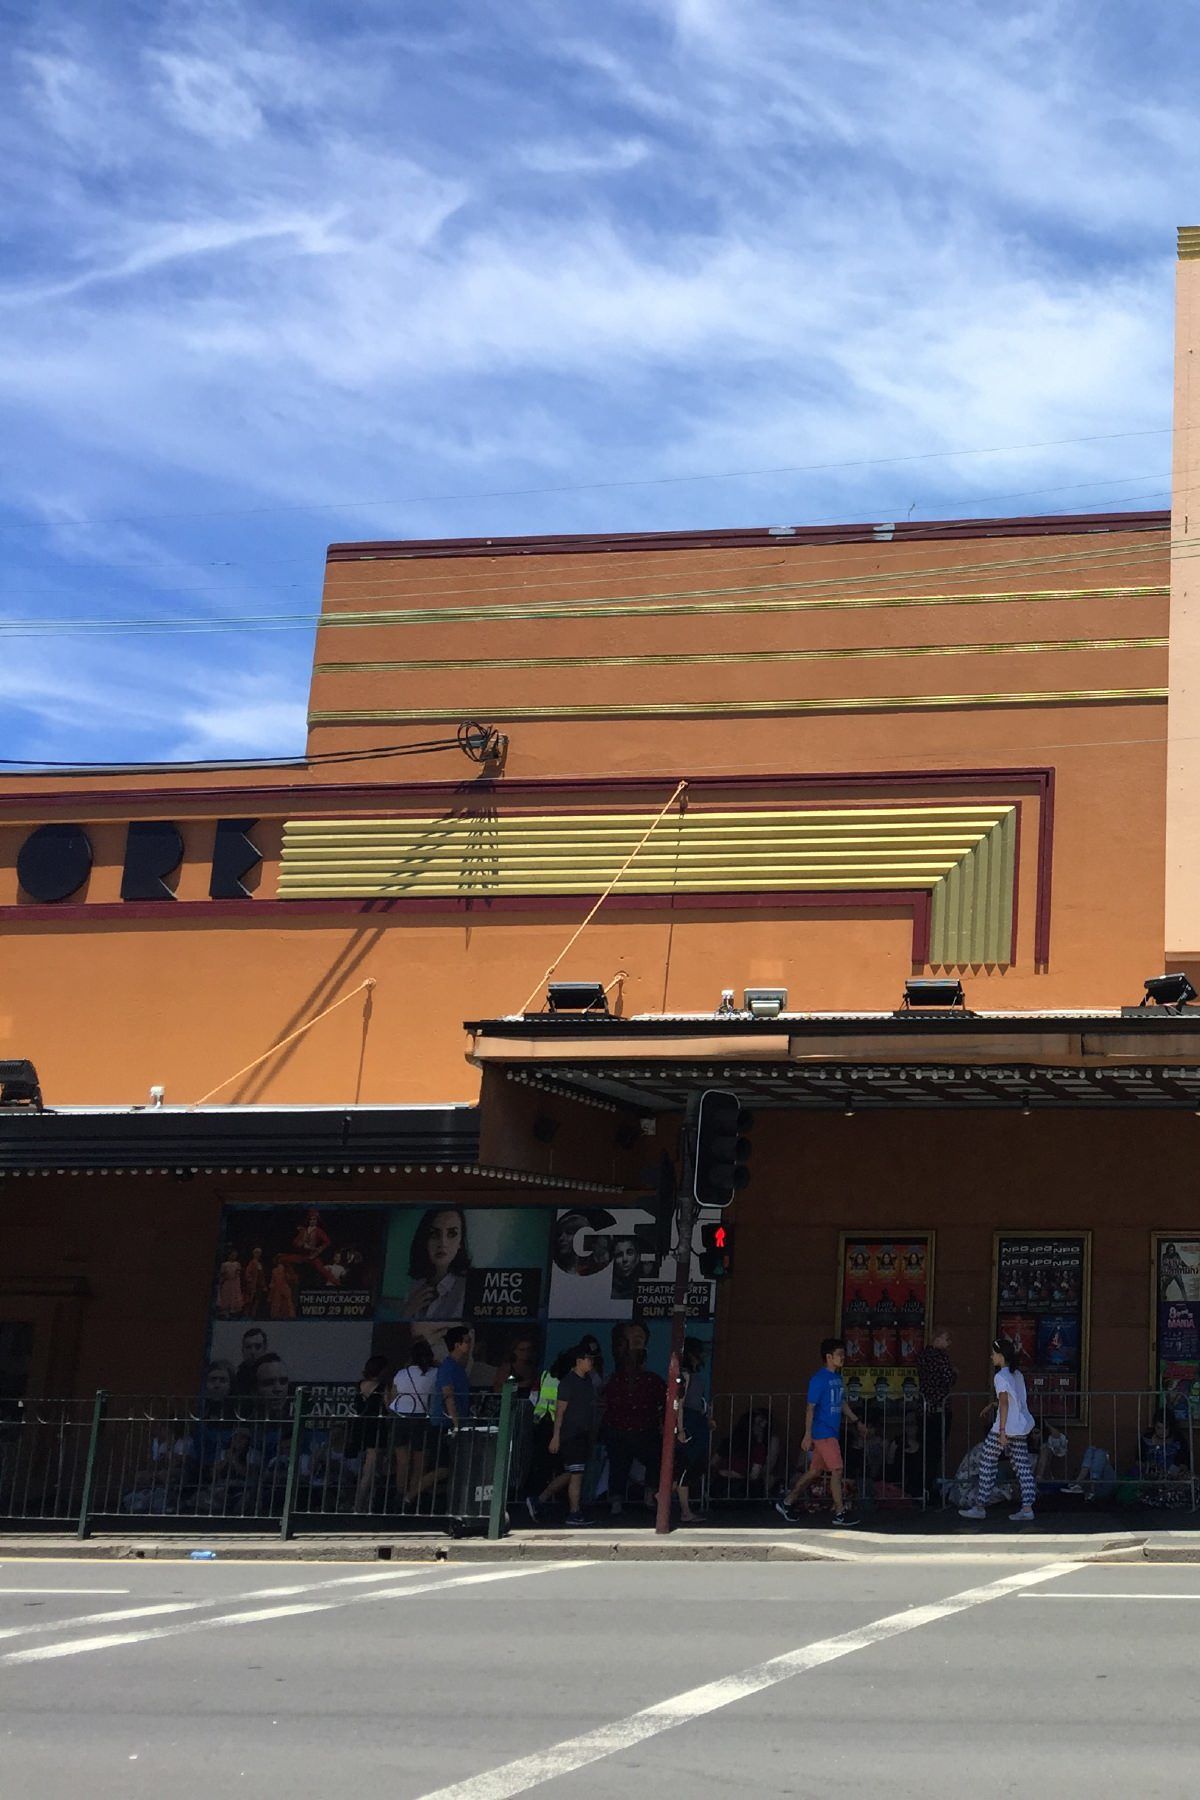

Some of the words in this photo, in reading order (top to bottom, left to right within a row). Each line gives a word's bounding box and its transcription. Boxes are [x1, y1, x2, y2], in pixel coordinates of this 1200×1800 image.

[483, 1272, 524, 1288] MEG
[299, 1294, 316, 1304] THE
[316, 1294, 371, 1304] NUTCRACKER
[481, 1289, 523, 1304] MAC
[689, 1295, 709, 1305] CUP
[301, 1305, 325, 1316] WED
[328, 1305, 341, 1316] 29
[343, 1305, 366, 1316] NOV
[473, 1306, 494, 1316] SAT
[495, 1306, 503, 1315] 2
[505, 1306, 528, 1316] DEC
[642, 1307, 665, 1317] SUN
